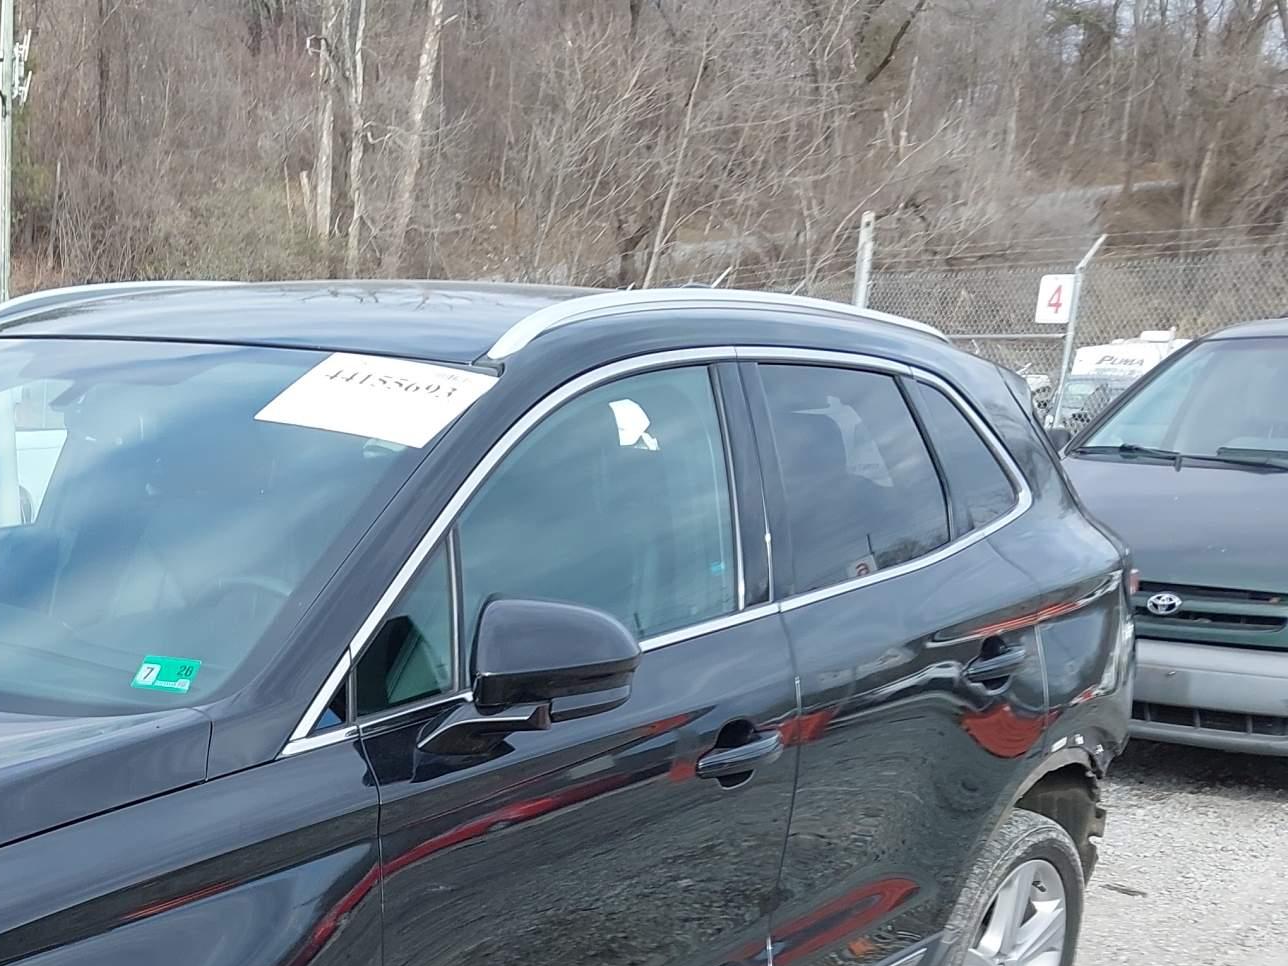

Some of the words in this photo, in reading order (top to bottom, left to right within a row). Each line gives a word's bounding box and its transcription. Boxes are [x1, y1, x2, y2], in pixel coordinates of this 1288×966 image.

[1047, 284, 1063, 314] 4
[1096, 355, 1145, 367] PUMA
[325, 369, 458, 400] 44155693
[142, 666, 155, 681] 7
